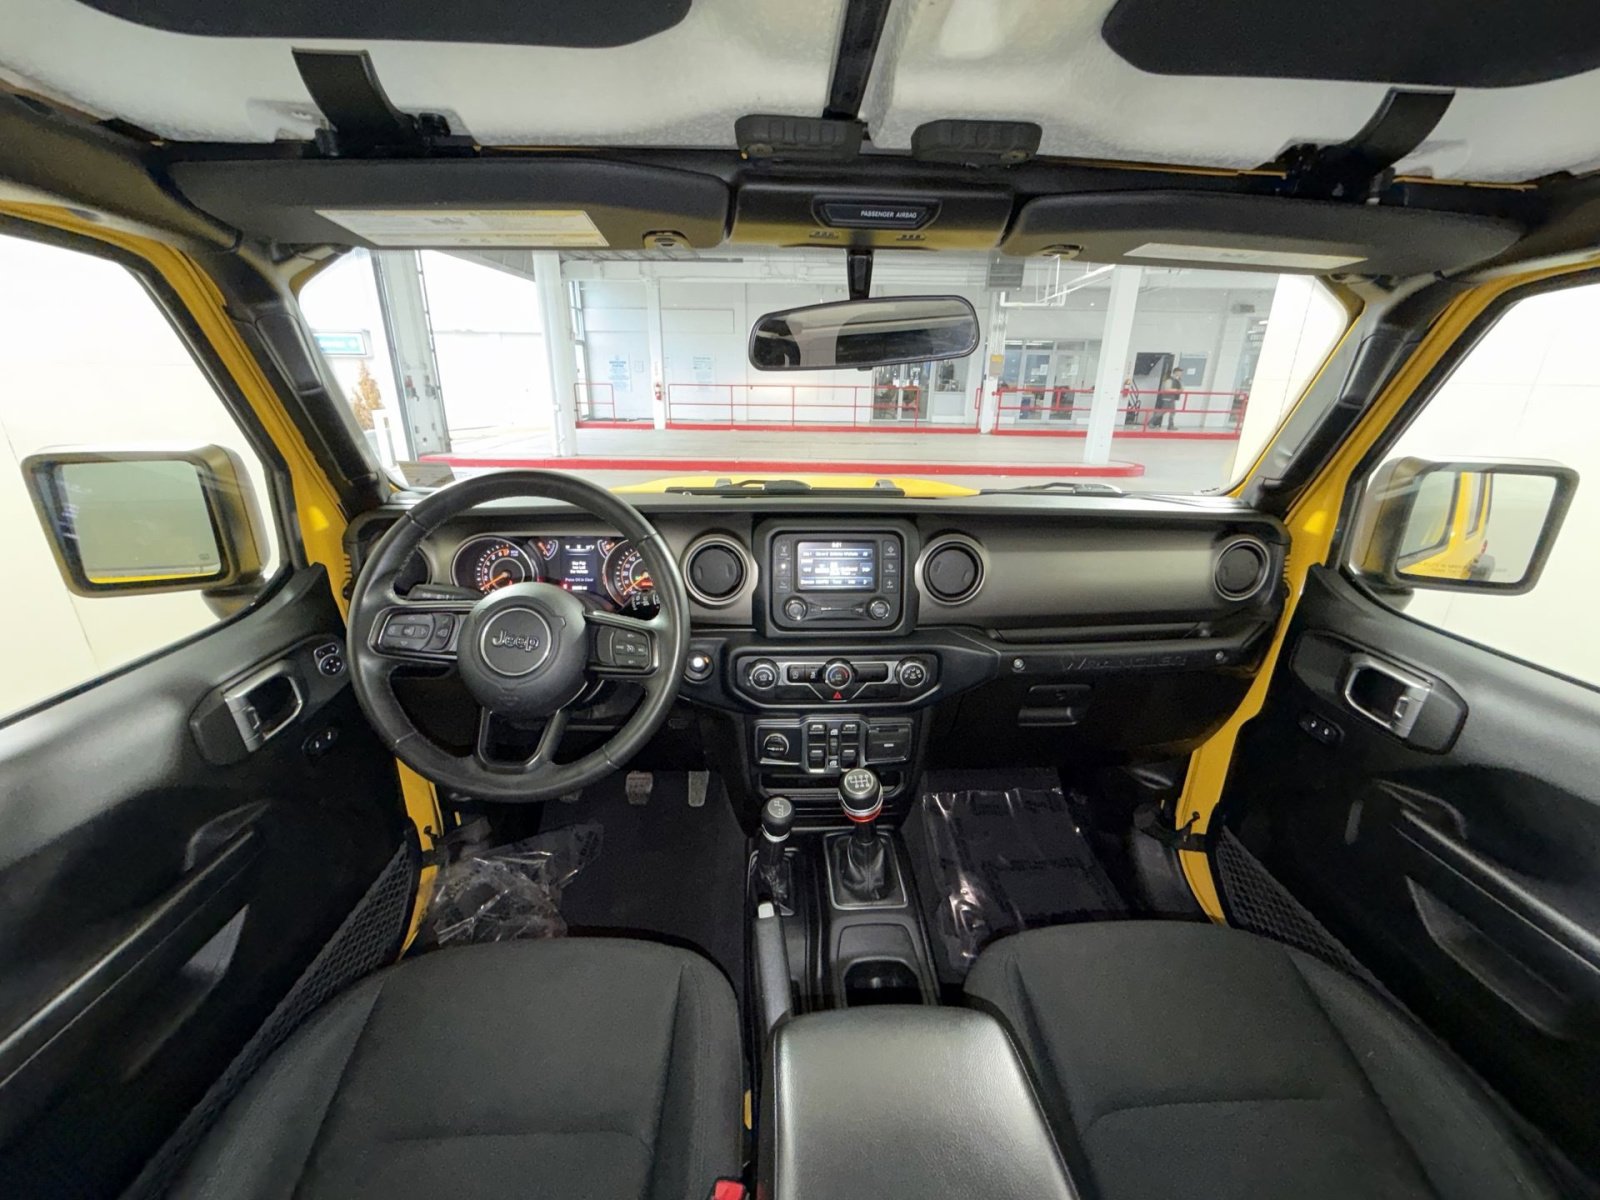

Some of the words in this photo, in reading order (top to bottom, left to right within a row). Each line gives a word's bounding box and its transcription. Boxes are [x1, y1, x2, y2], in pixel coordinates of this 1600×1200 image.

[860, 210, 894, 218] PASSENGER
[895, 211, 917, 219] AIRBAG
[492, 630, 539, 652] Jeep
